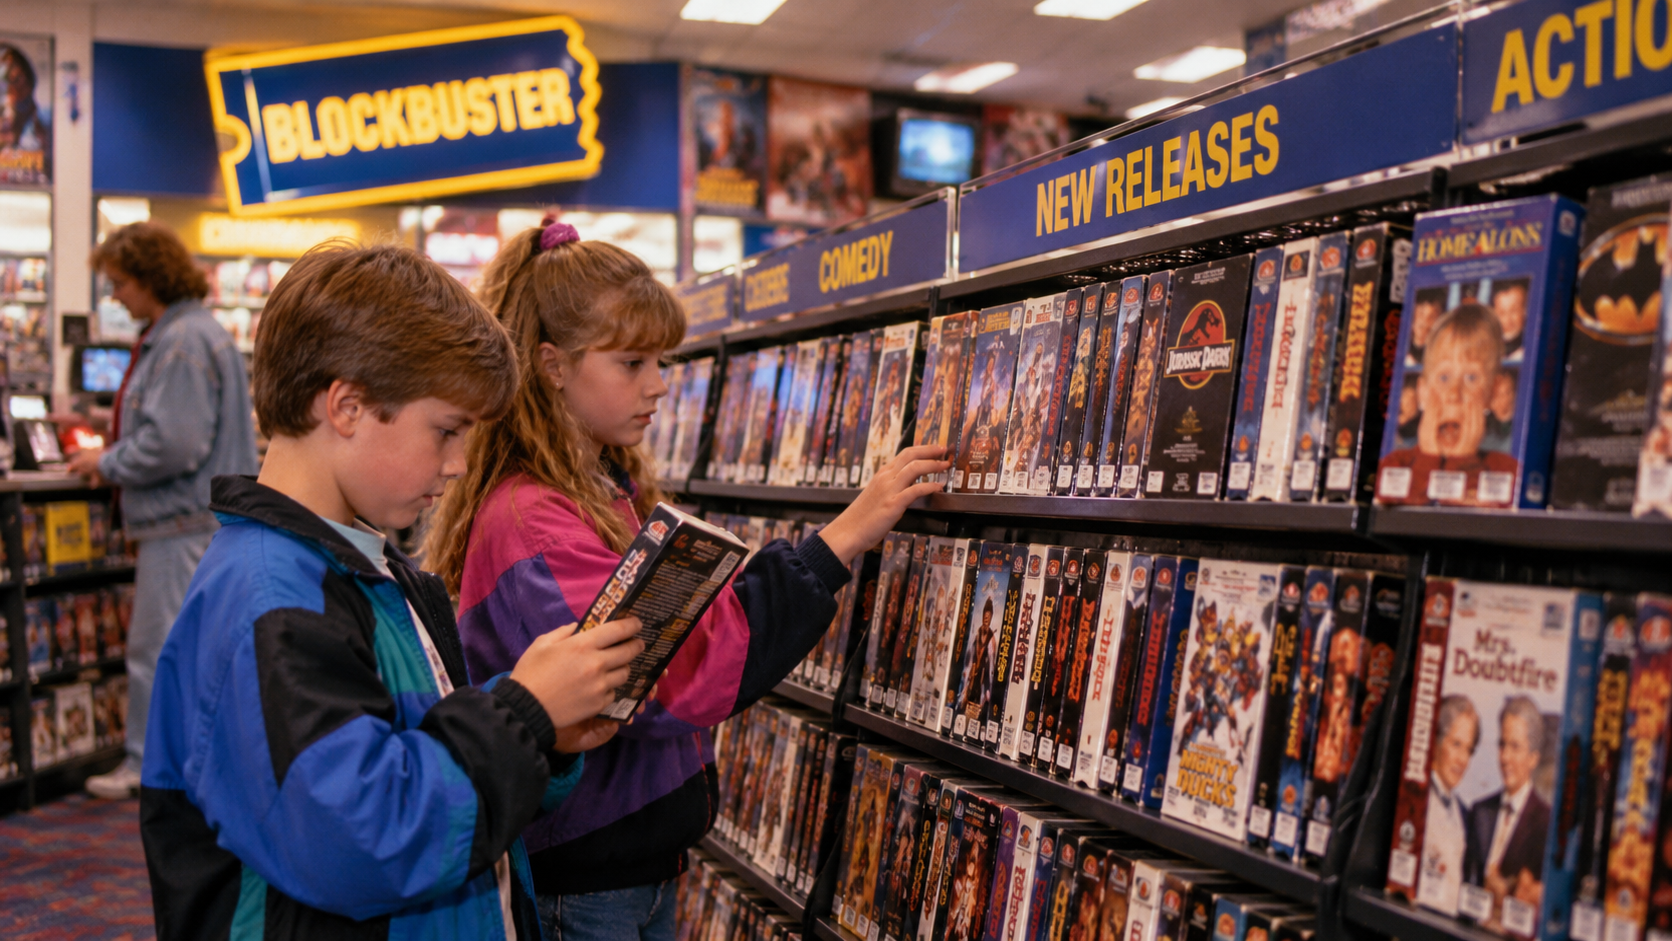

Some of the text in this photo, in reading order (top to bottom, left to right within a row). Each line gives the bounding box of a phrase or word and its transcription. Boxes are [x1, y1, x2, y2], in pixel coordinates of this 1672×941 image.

[260, 67, 577, 165] BLOCKBUSTER
[1036, 104, 1280, 237] NEW RELEASES
[819, 230, 893, 293] COMEDY
[1473, 627, 1516, 655] Mrs.
[1452, 646, 1557, 692] Doubtfire
[1176, 768, 1237, 809] DUCKS
